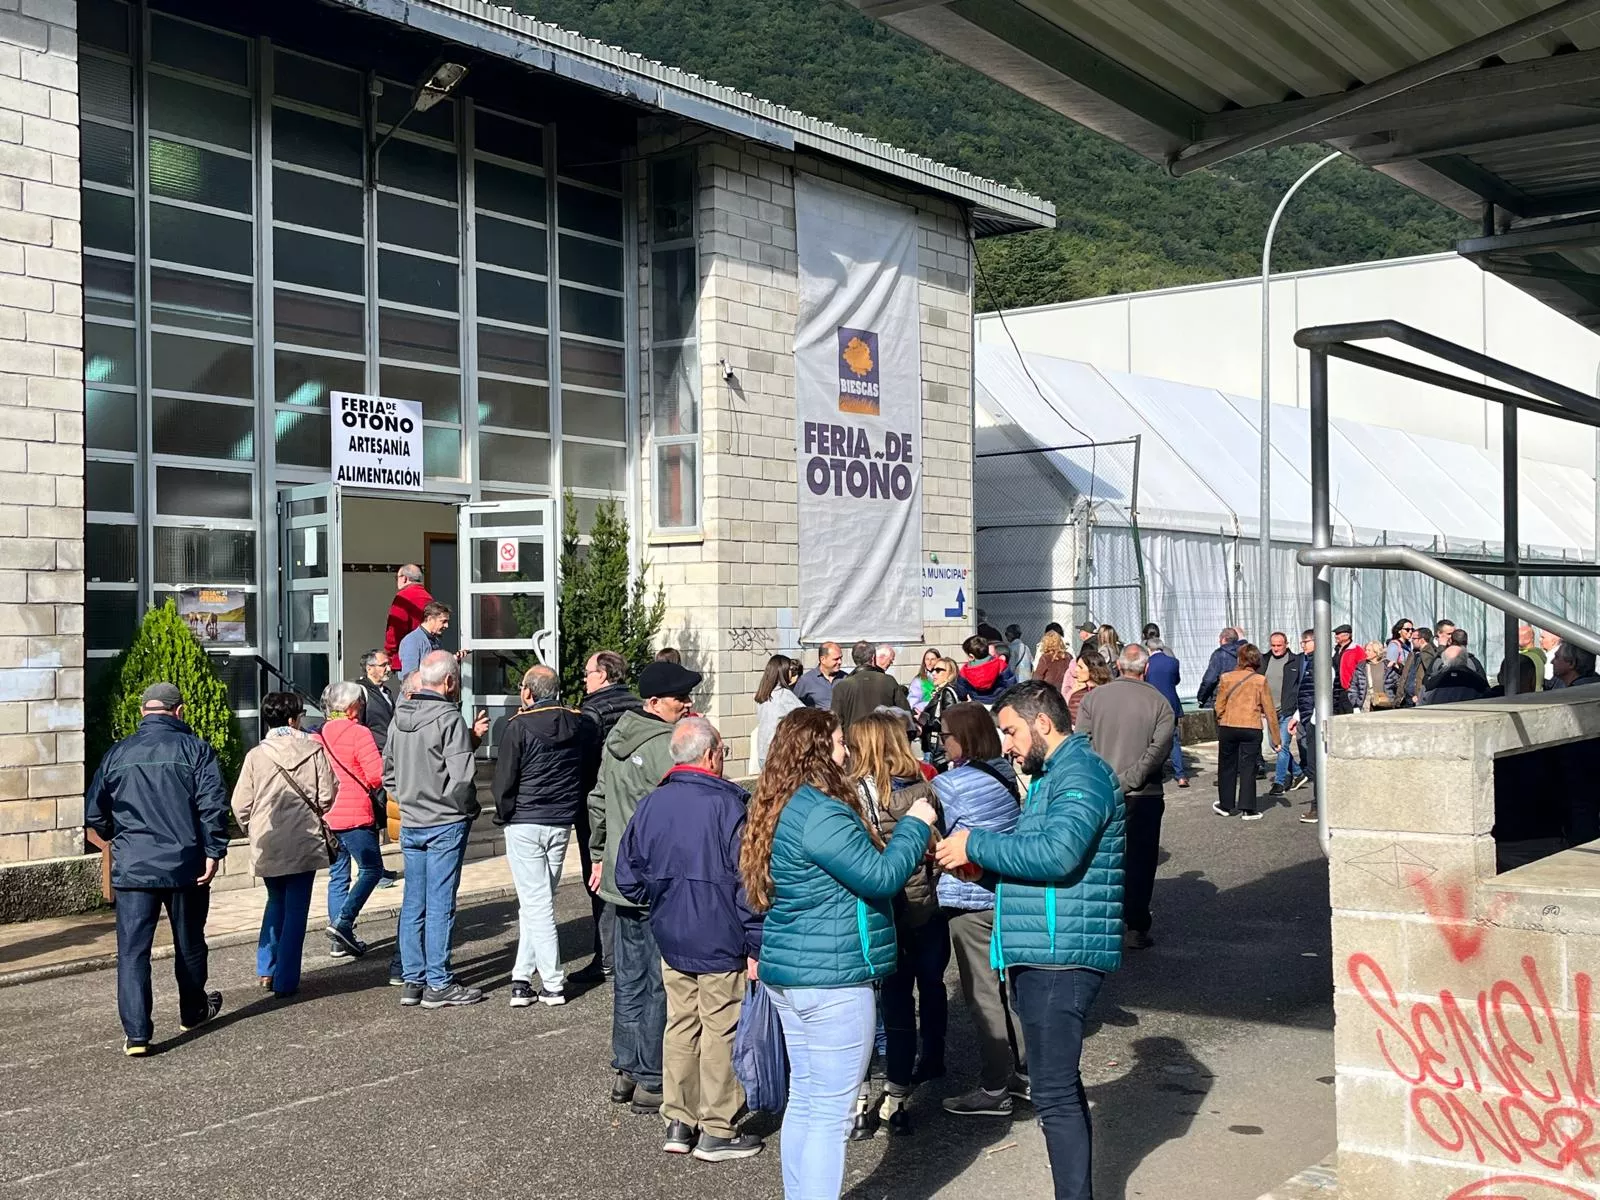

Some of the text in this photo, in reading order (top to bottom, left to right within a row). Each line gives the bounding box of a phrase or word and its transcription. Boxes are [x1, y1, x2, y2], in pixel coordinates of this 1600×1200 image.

[840, 378, 879, 398] BIESCAS
[341, 397, 397, 415] FERIA DE
[342, 411, 414, 434] OTOÑO
[349, 435, 411, 457] ARTESANÍA
[804, 421, 913, 463] FERIA DE
[377, 457, 383, 465] Y
[337, 464, 421, 487] ALIMENTACIÓN
[806, 451, 913, 501] OTOÑO
[927, 567, 966, 580] MUNICIPAL
